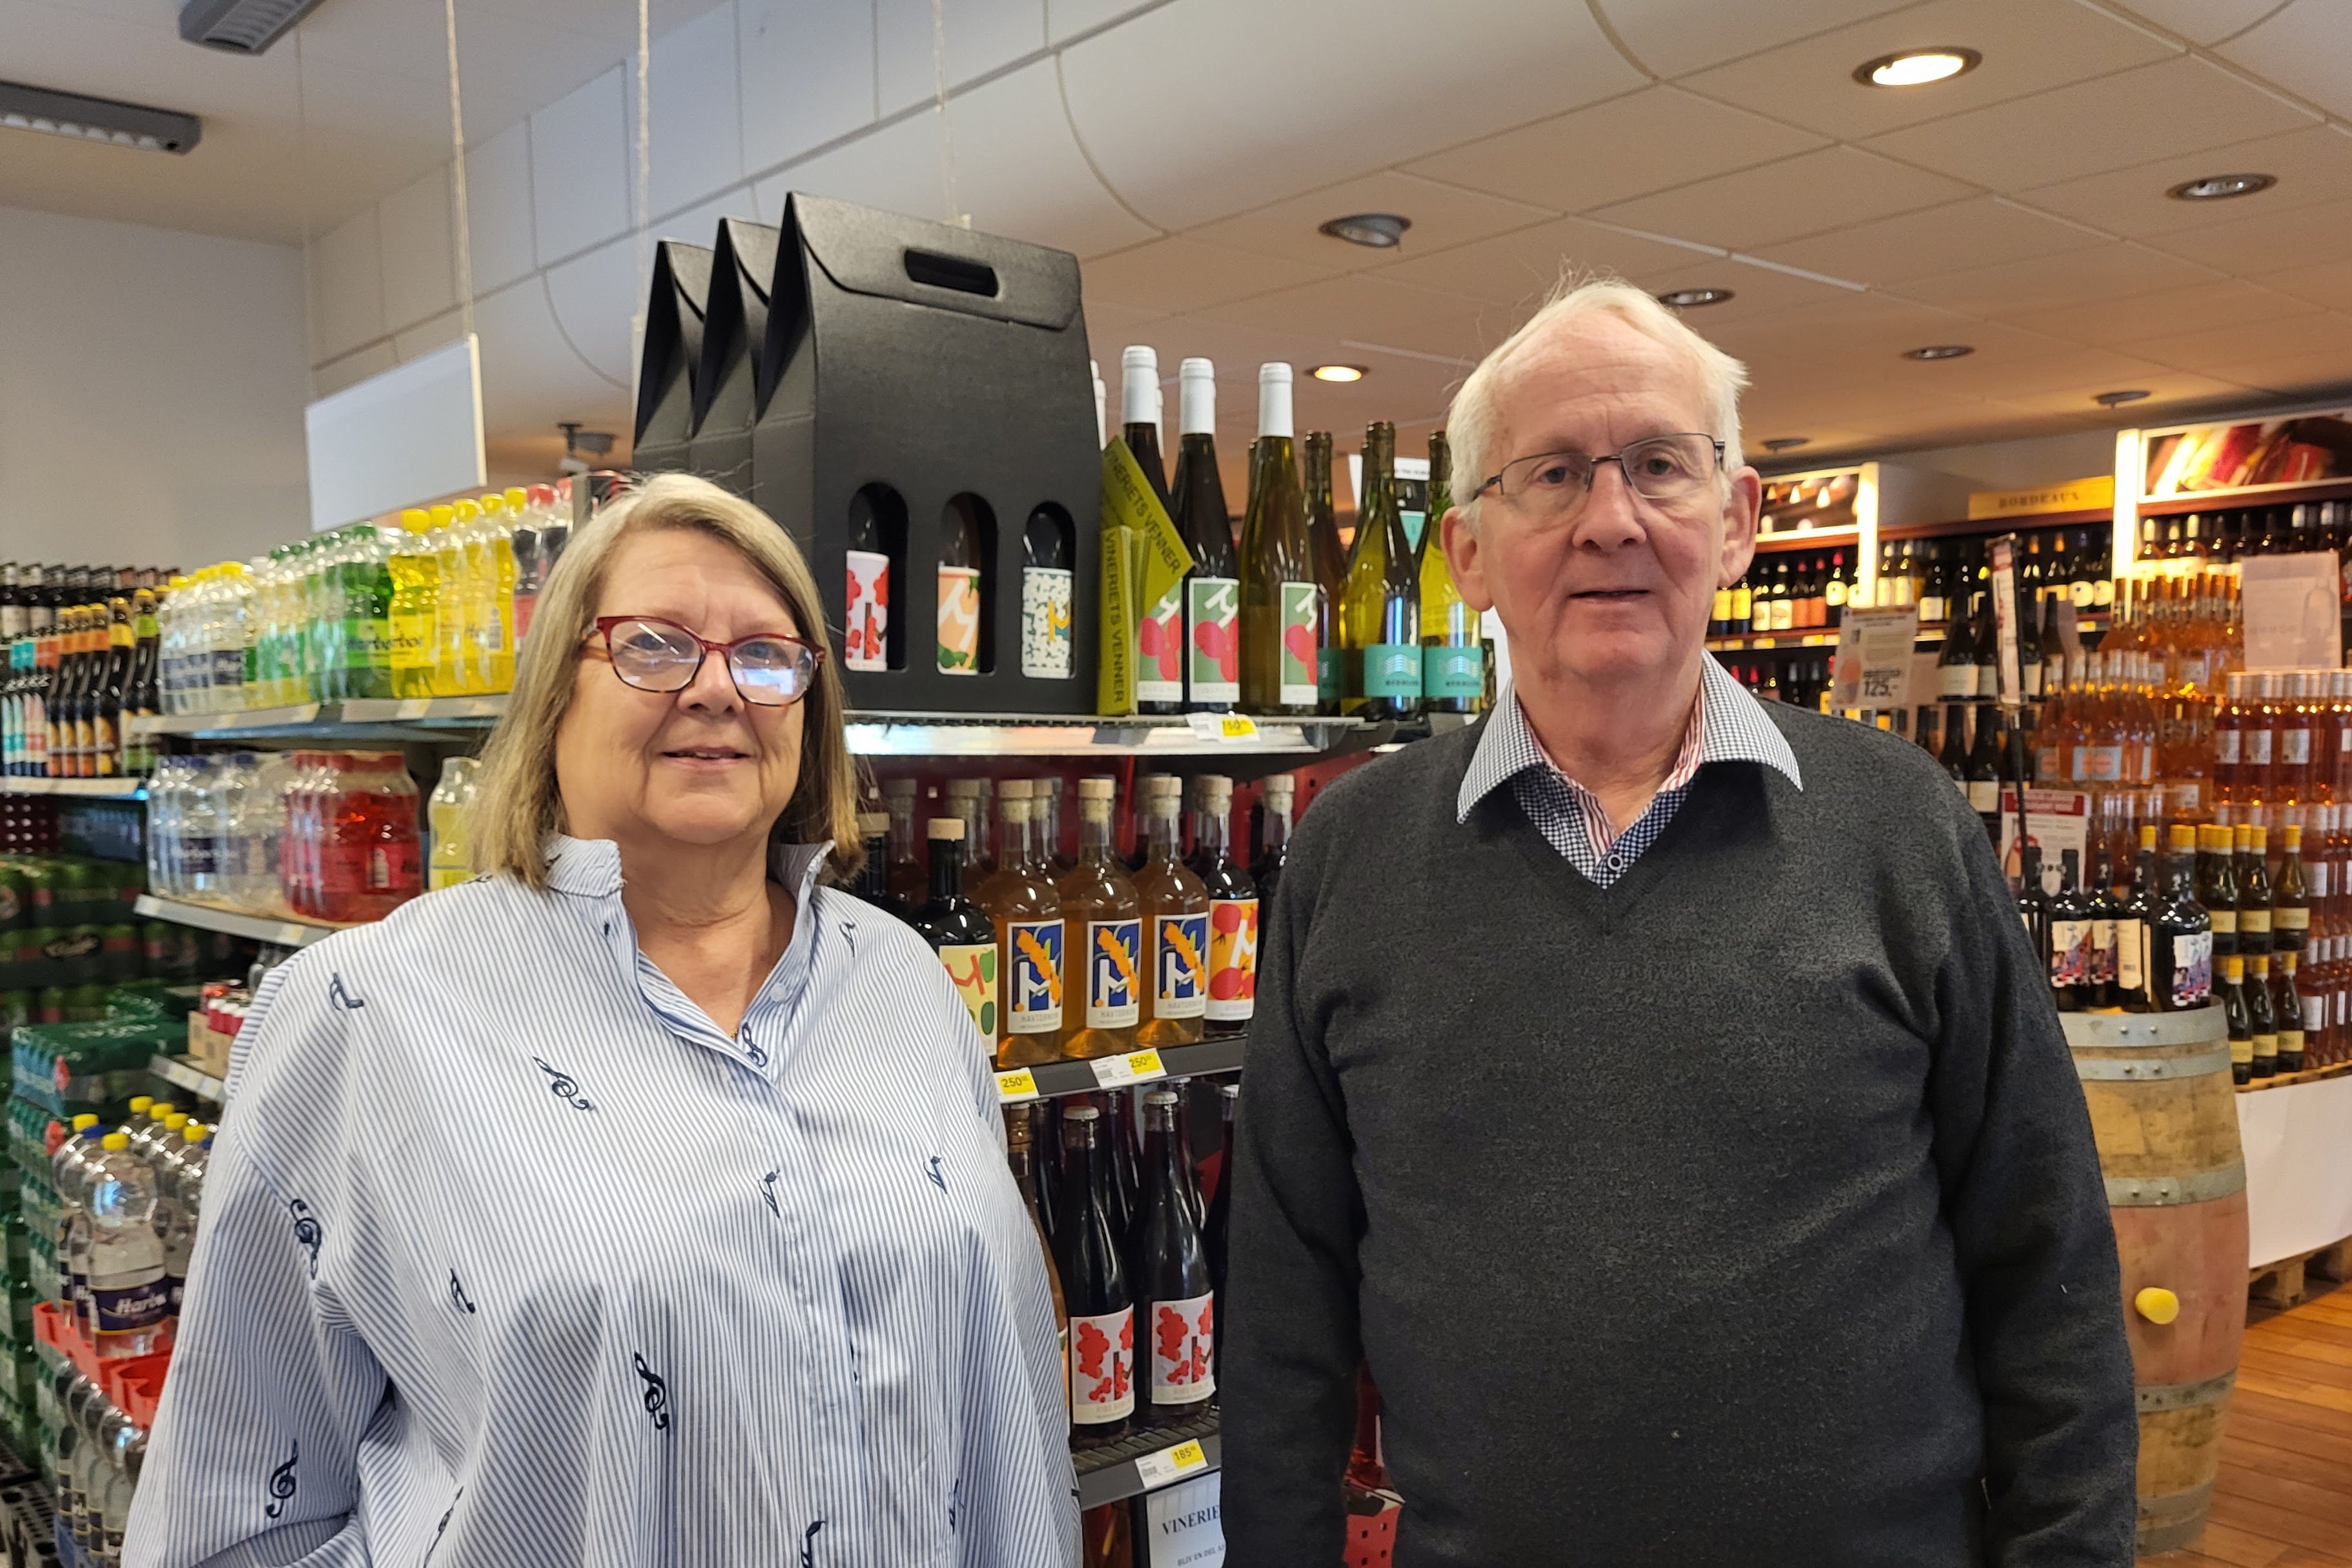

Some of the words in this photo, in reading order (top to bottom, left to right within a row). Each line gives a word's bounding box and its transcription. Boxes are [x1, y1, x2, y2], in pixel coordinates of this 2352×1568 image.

[1998, 491, 2080, 509] BORDEAUX
[1145, 514, 1181, 575] VENNER
[1105, 531, 1121, 626] VINERIETS
[1112, 629, 1125, 703] VENNER
[1129, 1056, 1147, 1068] 250
[1001, 1076, 1022, 1088] 250
[1174, 1447, 1192, 1462] 185
